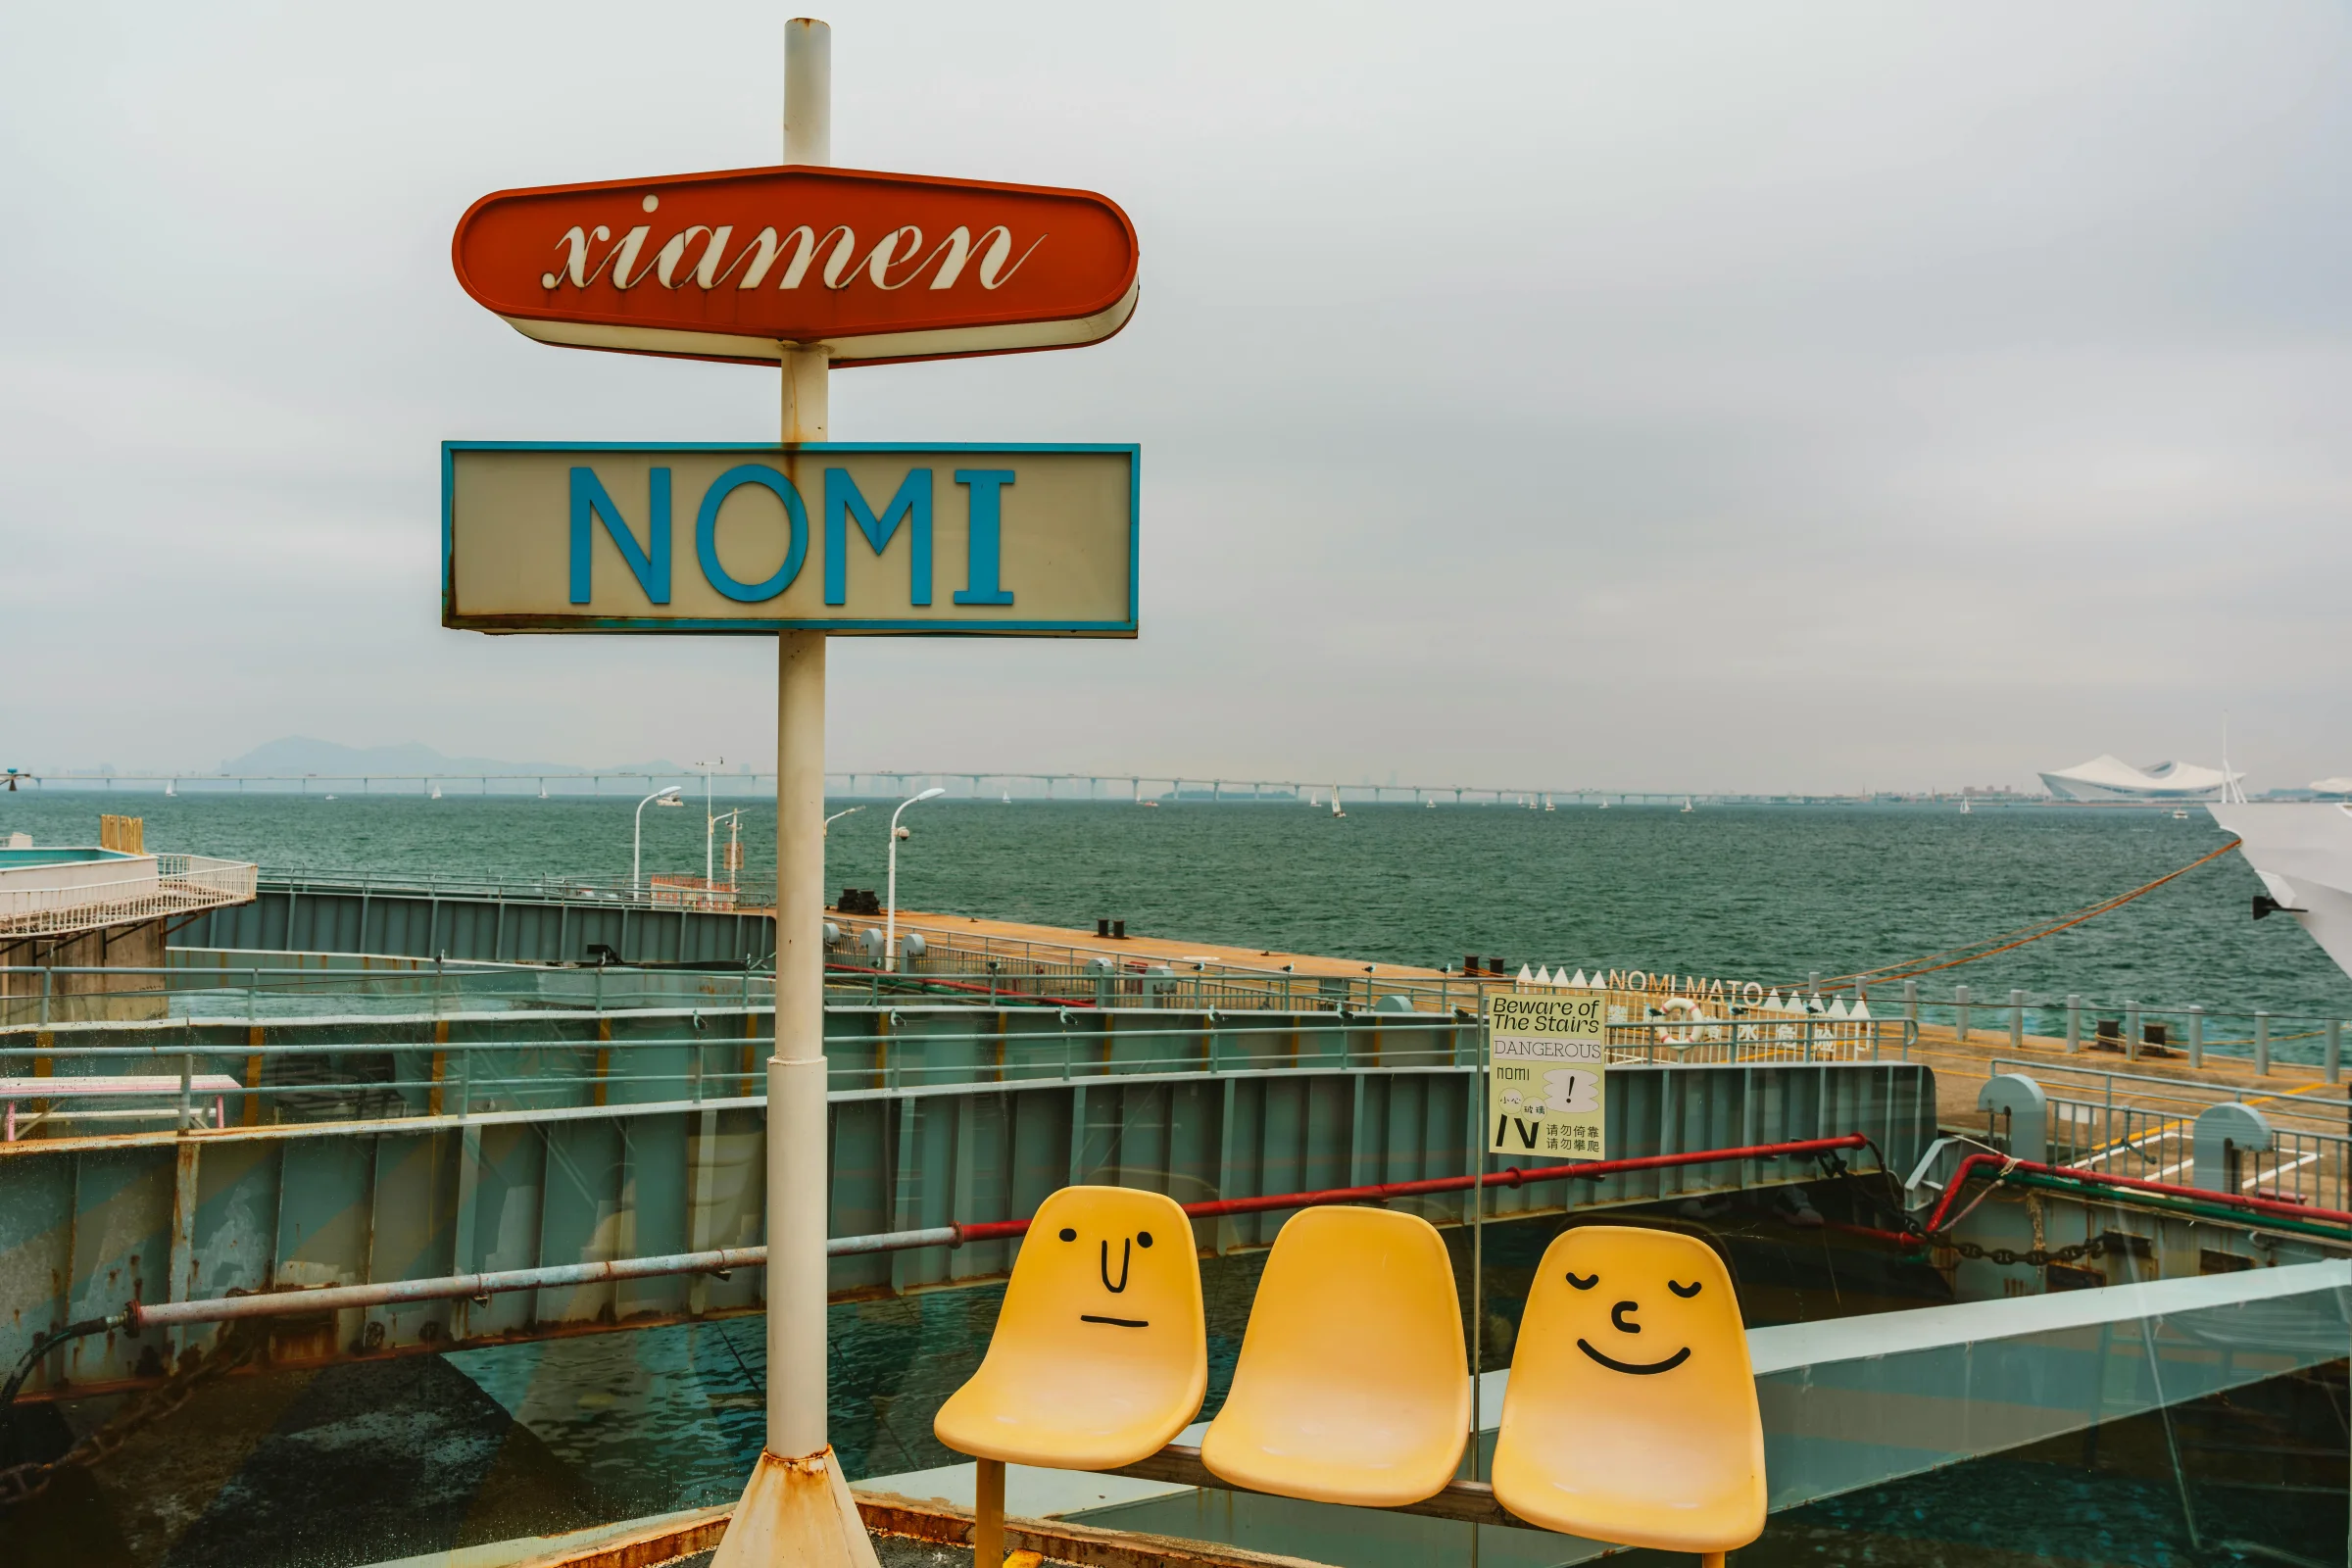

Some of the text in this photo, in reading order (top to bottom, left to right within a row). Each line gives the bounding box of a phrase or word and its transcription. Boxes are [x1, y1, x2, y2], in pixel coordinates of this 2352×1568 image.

[540, 193, 1050, 291] xiamen
[569, 464, 1016, 607] NOMI
[1608, 968, 1764, 1007] NOMI MATO
[1493, 998, 1600, 1019] Beware of
[1494, 1014, 1599, 1034] The Stairs
[1494, 1040, 1601, 1058] DANGEROUS
[1499, 1096, 1522, 1104] 小心
[1546, 1123, 1599, 1139] 请勿倚靠
[1546, 1137, 1600, 1152] 请勿攀爬
